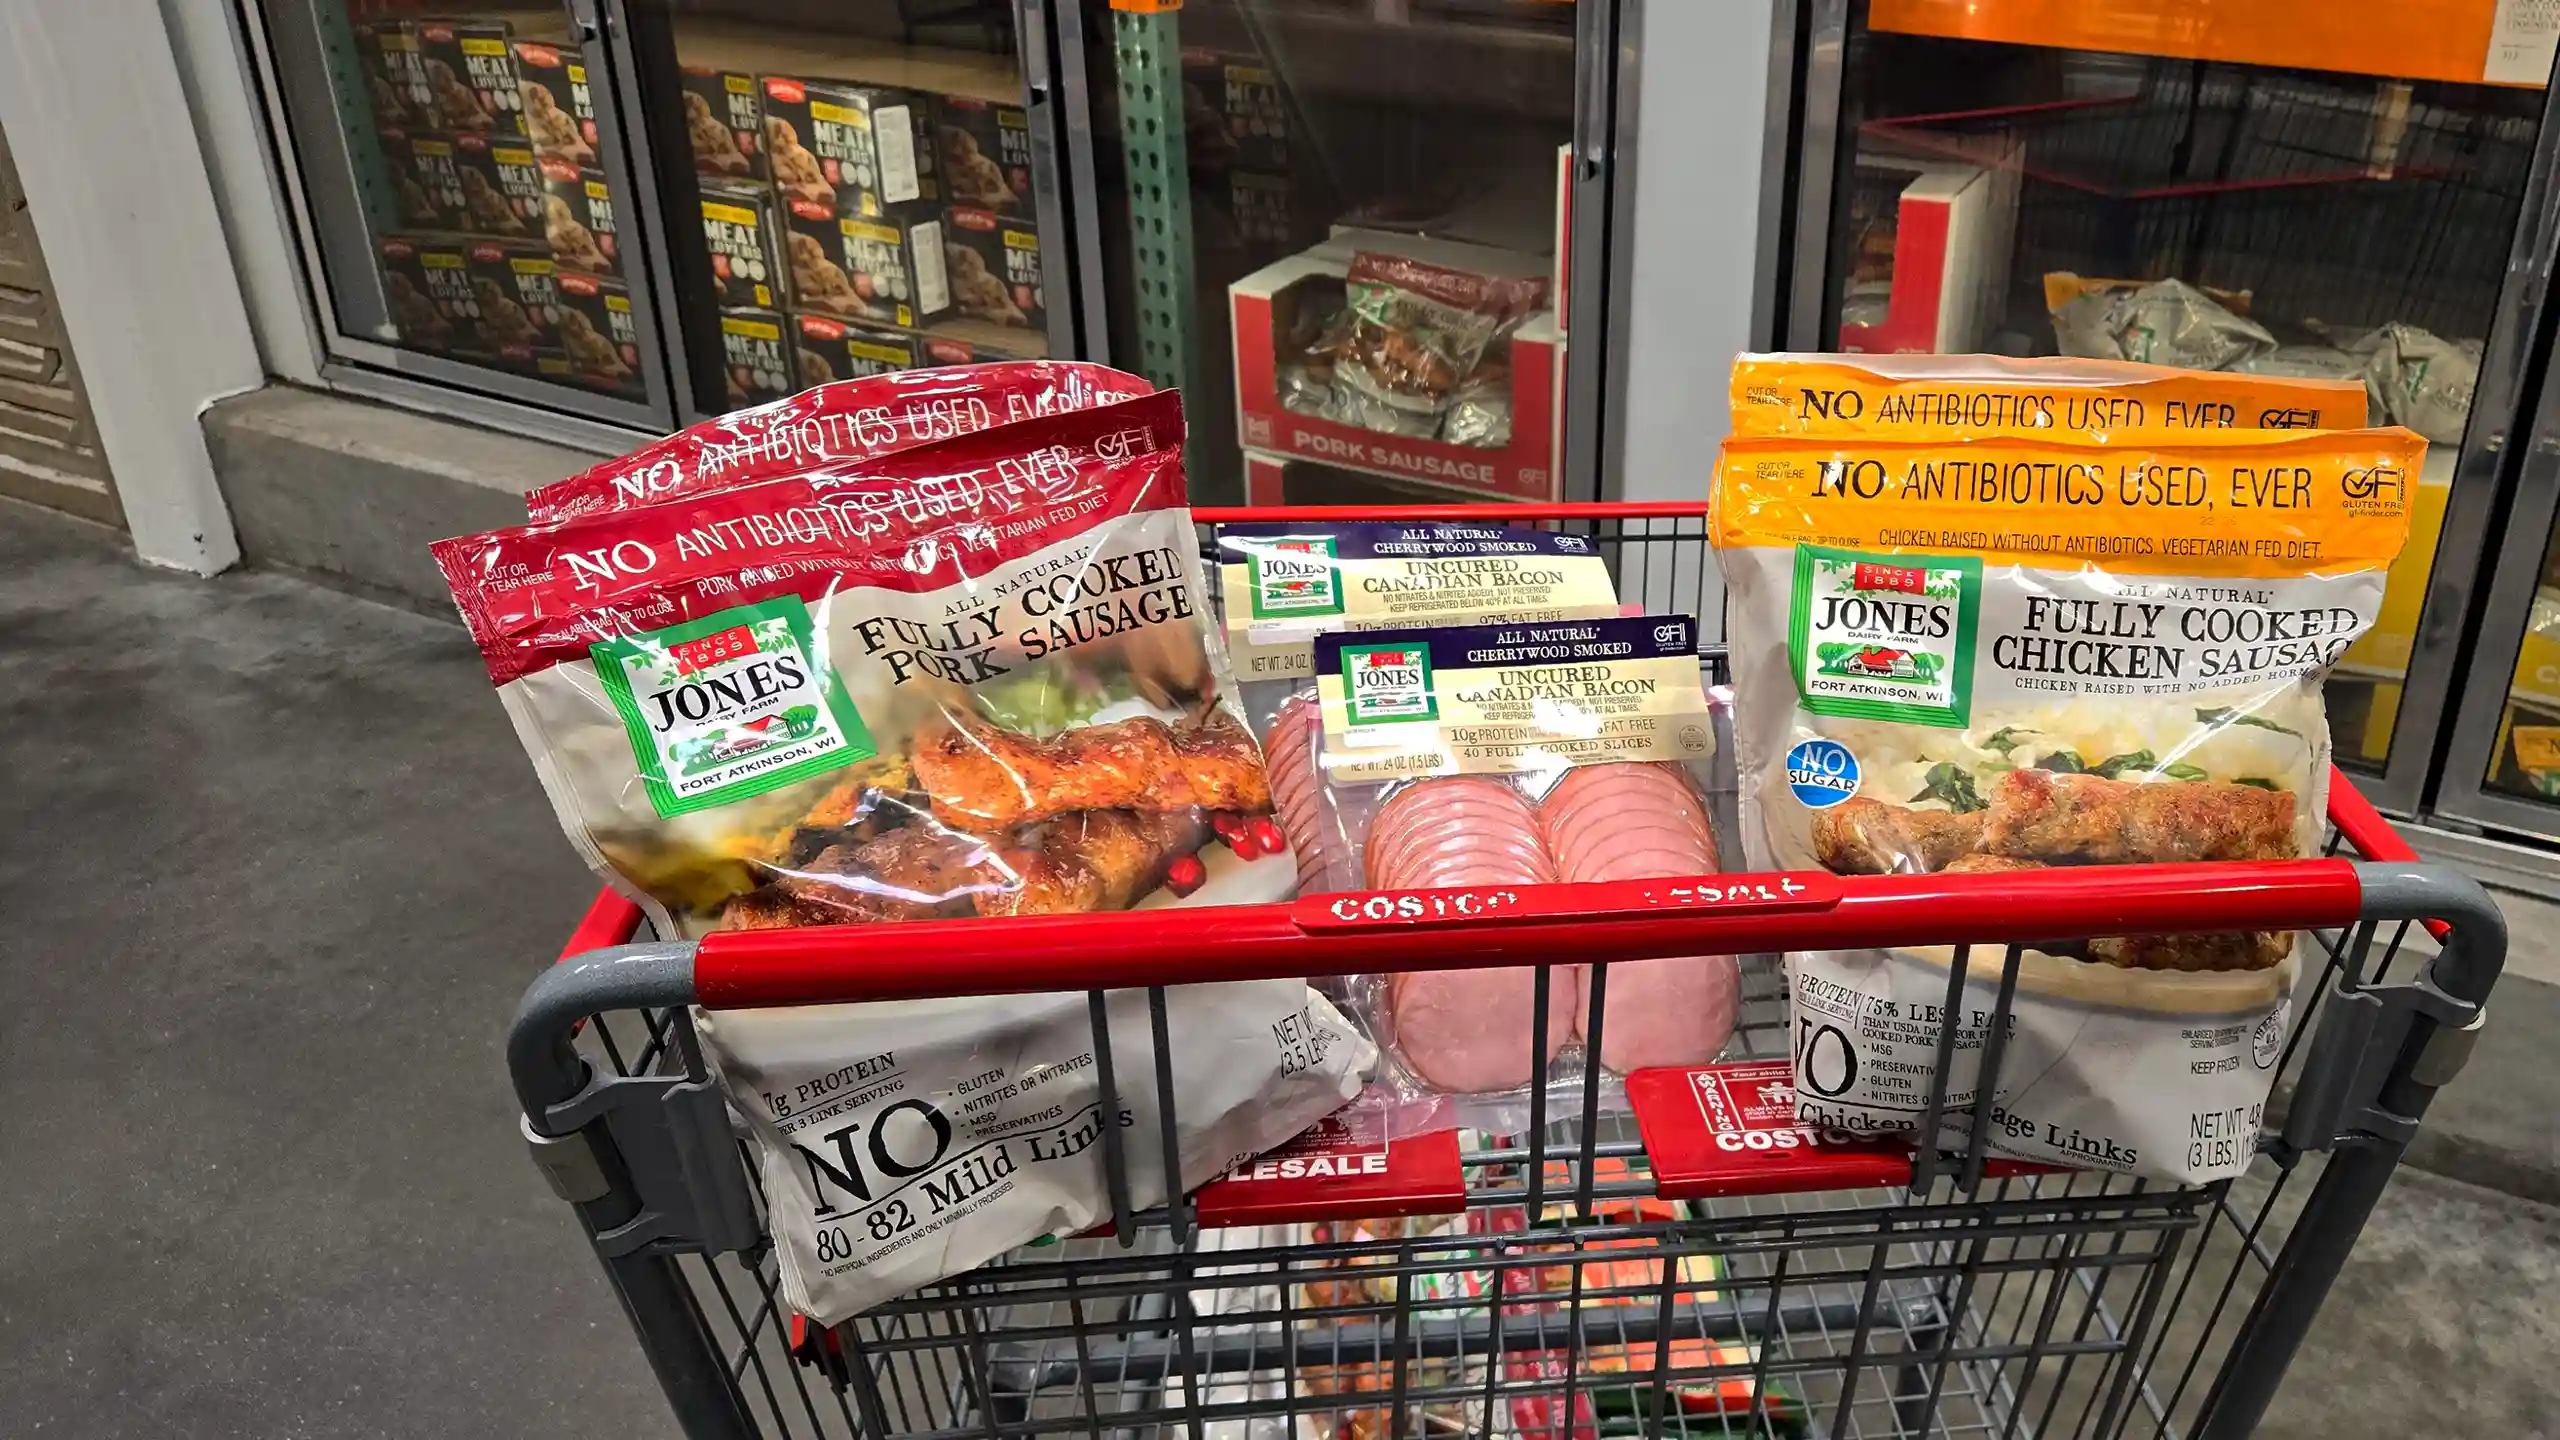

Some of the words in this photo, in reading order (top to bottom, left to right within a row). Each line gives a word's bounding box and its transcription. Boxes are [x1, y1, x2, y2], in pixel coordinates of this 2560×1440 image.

[703, 218, 758, 242] MEAT
[1797, 388, 1865, 420] NO
[1876, 393, 2056, 430] ANTIBIOTICS
[2164, 400, 2236, 430] EVER
[610, 457, 684, 511] NO
[697, 405, 897, 480] ANTIBIOTICS
[1293, 430, 1366, 461] PORK
[1370, 447, 1497, 484] SAUSAGE
[1811, 460, 1887, 499] NO
[1901, 462, 2104, 506] ANTIBIOTICS
[2119, 464, 2214, 512] USED,
[2231, 467, 2312, 509] EVER
[2342, 500, 2382, 510] GLUTEN
[2348, 508, 2404, 519] gf-finder.com
[558, 540, 657, 591] NO
[675, 494, 889, 562] ANTIBIOTICS
[996, 445, 1079, 494] EVER
[697, 575, 739, 598] PORK
[795, 556, 866, 574] WITHOUT
[1051, 507, 1077, 528] FED
[1078, 492, 1110, 516] DIET
[1401, 528, 1430, 540] ALL
[1879, 529, 1937, 548] CHICKEN
[1942, 531, 1988, 549] RAISED
[1992, 533, 2062, 551] WITHOUT
[2162, 538, 2249, 558] VEGETARIAN
[2255, 540, 2282, 558] FED
[2287, 541, 2325, 560] DIET.
[1373, 542, 1477, 554] CHERRYWOOD
[1479, 541, 1538, 553] SMOKED
[484, 566, 510, 582] CUT
[510, 562, 530, 576] OR
[1262, 558, 1328, 579] JONES
[1405, 558, 1520, 577] UNCURED
[1864, 565, 1915, 579] SINCE
[488, 574, 523, 595] TEAR
[522, 570, 556, 588] HERE
[1363, 573, 1483, 594] CANADIAN
[1492, 570, 1565, 587] BACON
[1864, 575, 1915, 588] 1889
[852, 605, 1005, 656] FULLY
[1020, 546, 1185, 617] COOKED
[944, 595, 985, 617] ALL
[1382, 594, 1394, 604] NO
[1394, 591, 1429, 603] NITRATES
[1436, 589, 1466, 601] NITRITES
[1499, 586, 1513, 598] NOT
[1389, 602, 1408, 614] KEEP
[1408, 599, 1459, 613] REFRIGERATED
[1459, 598, 1485, 610] BELOW
[1502, 597, 1512, 607] AT
[1511, 596, 1526, 607] ALL
[634, 608, 647, 622] TO
[647, 602, 676, 620] CLOSE
[1511, 612, 1534, 625] FAT
[1536, 609, 1564, 622] FREE
[1815, 597, 1951, 639] JONES
[2023, 596, 2166, 639] FULLY
[2181, 607, 2360, 645] COOKED
[1383, 617, 1434, 630] PROTEIN
[881, 645, 1011, 686] PORK
[1018, 585, 1195, 662] SAUSAGE
[1496, 631, 1525, 645] ALL
[1847, 631, 1883, 641] DAIRY
[1887, 634, 1920, 645] FARM
[1467, 646, 1571, 663] CHERRYWOOD
[1573, 642, 1632, 658] SMOKED
[1993, 634, 2186, 680] CHICKEN
[1251, 655, 1267, 673] NET
[1266, 655, 1284, 671] WT.
[1284, 655, 1295, 670] 24
[1356, 669, 1420, 689] JONES
[1498, 666, 1611, 687] UNCURED
[2015, 677, 2079, 693] CHICKEN
[2084, 682, 2136, 696] RAISED
[2143, 683, 2182, 695] WITH
[2188, 680, 2207, 692] NO
[2212, 673, 2262, 689] ADDED
[648, 655, 806, 733] JONES
[1456, 684, 1575, 703] CANADIAN
[1583, 679, 1656, 697] BACON
[1588, 697, 1604, 707] NOT
[1811, 680, 1846, 693] FORT
[1849, 684, 1921, 701] ATKINSON,
[1926, 691, 1944, 703] WI
[740, 696, 780, 716] FARM
[1484, 711, 1501, 721] KEEP
[1487, 702, 1521, 712] NITRATES
[1595, 705, 1604, 715] AT
[1604, 704, 1617, 714] ALL
[1451, 728, 1477, 745] 10g
[1478, 727, 1529, 741] PROTEIN
[1604, 720, 1629, 734] FAT
[1629, 718, 1658, 731] FREE
[1463, 746, 1480, 758] 40
[1540, 740, 1599, 754] COOKED
[1604, 736, 1653, 750] SLICES
[680, 772, 722, 793] FORT
[728, 748, 814, 780] ATKINSON,
[815, 735, 837, 757] WI
[1801, 743, 1847, 776] NO
[1789, 769, 1857, 793] SUGAR
[1799, 973, 1862, 1008] PROTEIN
[1865, 996, 1900, 1019] 75%
[1272, 1013, 1303, 1050] NET
[1863, 1016, 1890, 1030] THAN
[1894, 1021, 1921, 1035] USDA
[1862, 1028, 1902, 1043] COOKED
[1904, 1034, 1934, 1047] PORK
[1871, 1044, 1893, 1057] MSG
[2190, 1061, 2216, 1075] KEEP
[763, 1091, 793, 1117] 7g
[795, 1051, 897, 1104] PROTEIN
[957, 1067, 1005, 1096] GLUTEN
[964, 1085, 1018, 1114] NITRITES
[1020, 1076, 1037, 1094] OR
[1039, 1052, 1094, 1083] NITRATES
[1870, 1075, 1912, 1090] GLUTEN
[799, 1116, 807, 1129] 3
[808, 1103, 843, 1126] LINK
[844, 1080, 905, 1112] SERVING
[1871, 1091, 1918, 1106] NITRITES
[970, 1111, 997, 1127] MSG
[975, 1104, 1064, 1138] PRESERVATIVES
[1799, 1102, 1919, 1132] Chicken
[2189, 1112, 2222, 1139] NET
[2225, 1107, 2246, 1135] WT.
[2045, 1122, 2137, 1165] Links
[790, 1097, 952, 1217] NO
[2059, 1149, 2135, 1171] APPROXIMATELY
[2187, 1142, 2203, 1172] (3
[2204, 1138, 2240, 1171] LBS.)
[816, 1226, 853, 1264] 80
[866, 1199, 918, 1242] 82
[918, 1144, 1018, 1216] Mild
[867, 1236, 912, 1266] INGREDIENTS
[911, 1227, 927, 1242] AND
